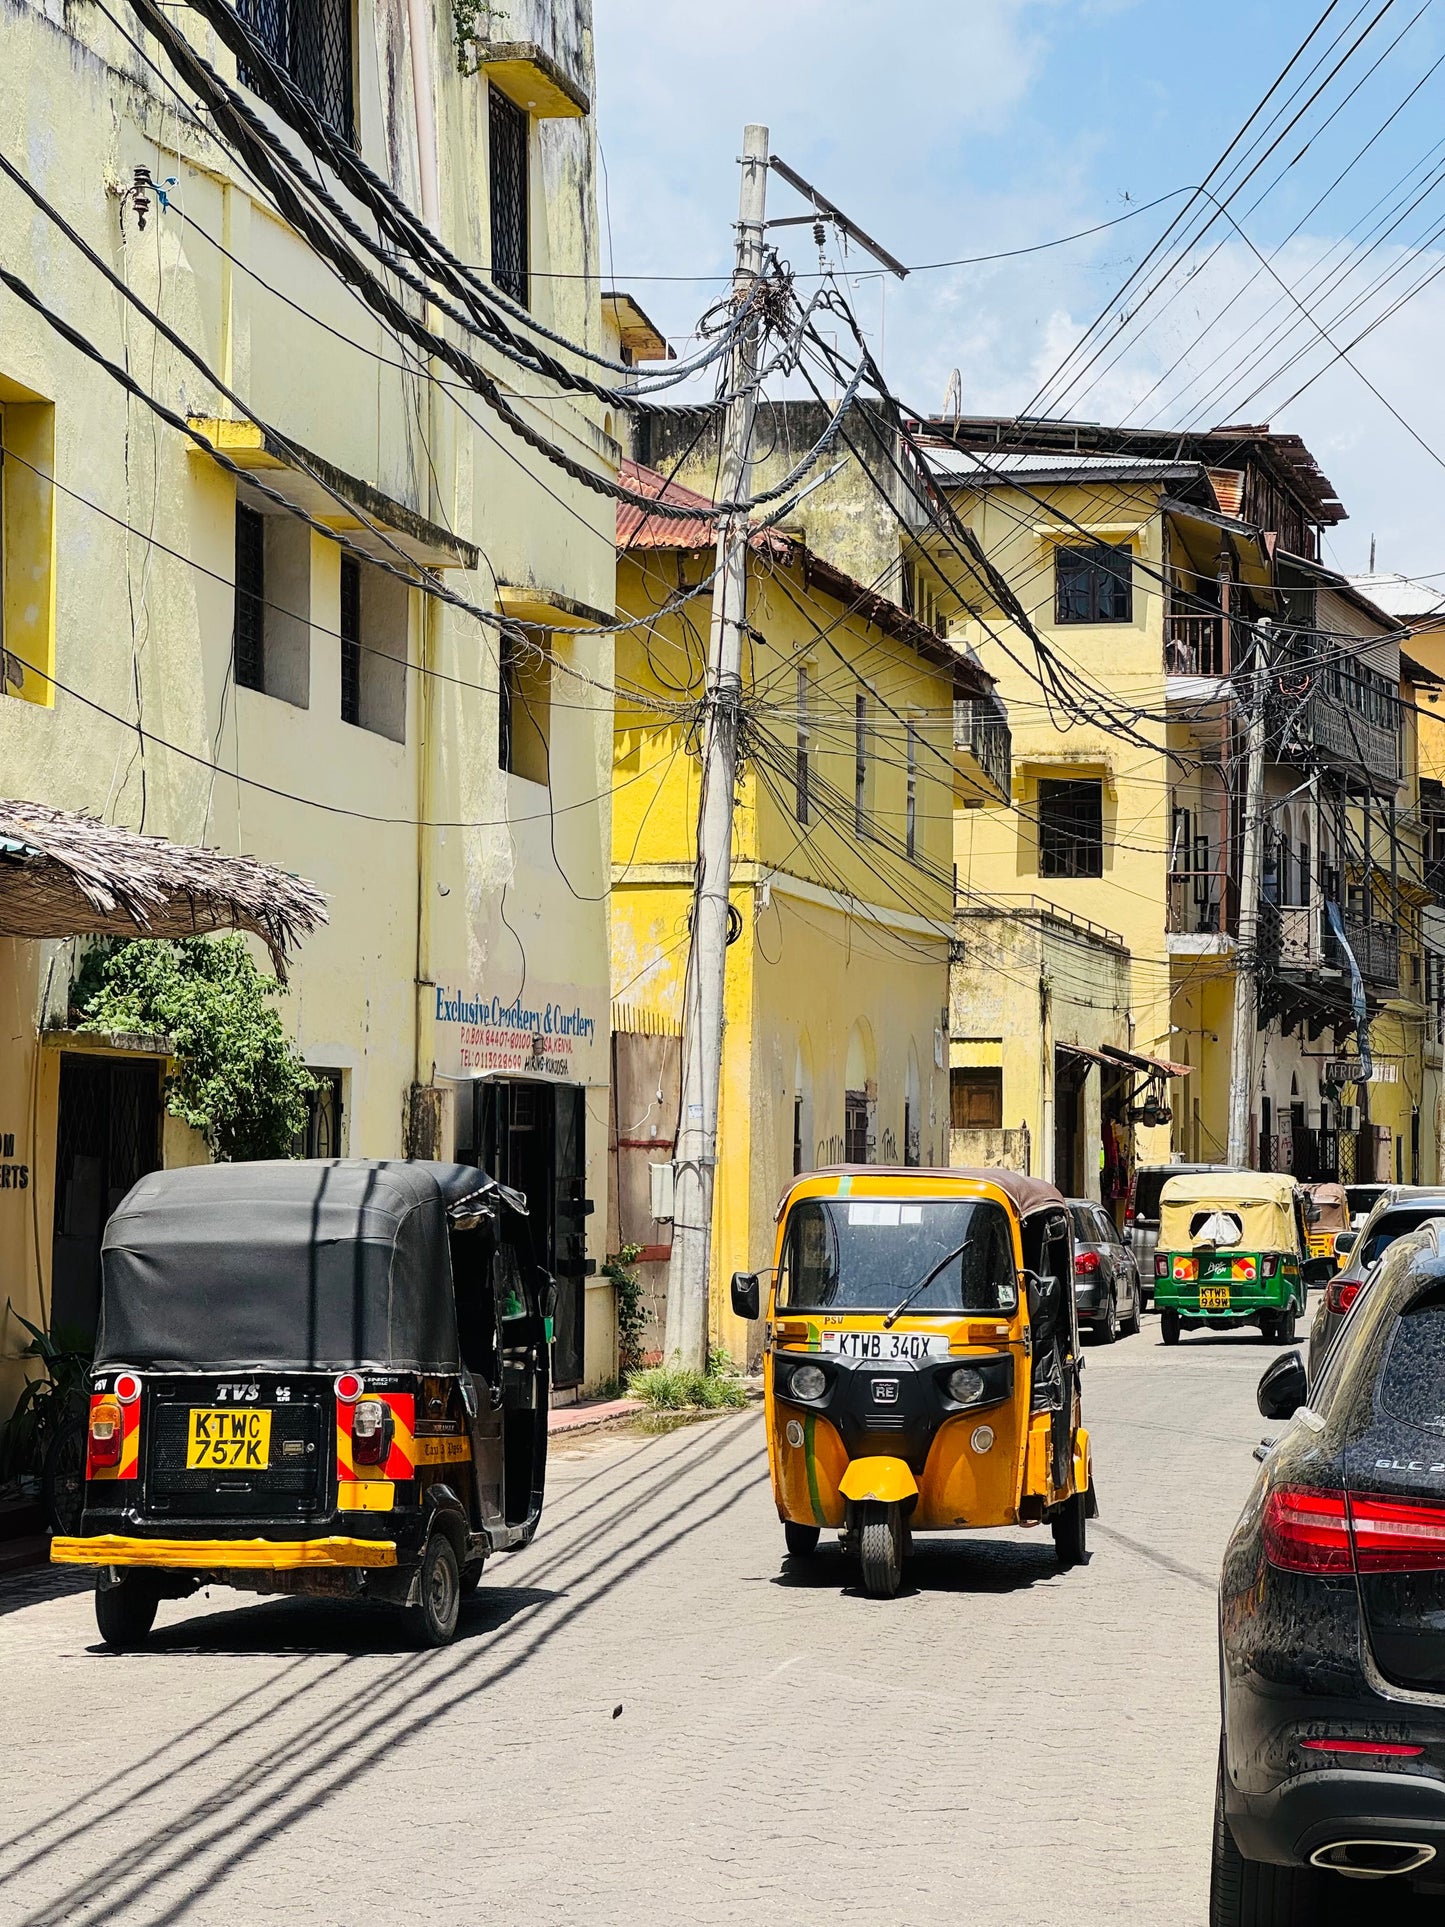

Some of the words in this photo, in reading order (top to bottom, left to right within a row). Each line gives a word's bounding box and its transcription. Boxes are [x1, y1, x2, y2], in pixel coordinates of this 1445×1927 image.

[436, 986, 490, 1027] Exclusive
[491, 995, 543, 1036] Crockery
[543, 1002, 553, 1034] &
[553, 1004, 596, 1048] Curtlery
[824, 1316, 844, 1325] PSV
[840, 1333, 881, 1358] KTWB
[890, 1335, 931, 1360] 340X
[216, 1383, 261, 1401] TVS
[275, 1385, 292, 1397] 65
[875, 1386, 895, 1398] RE
[195, 1413, 261, 1439] KTWC
[194, 1439, 262, 1465] 757K
[1375, 1459, 1424, 1472] GLC
